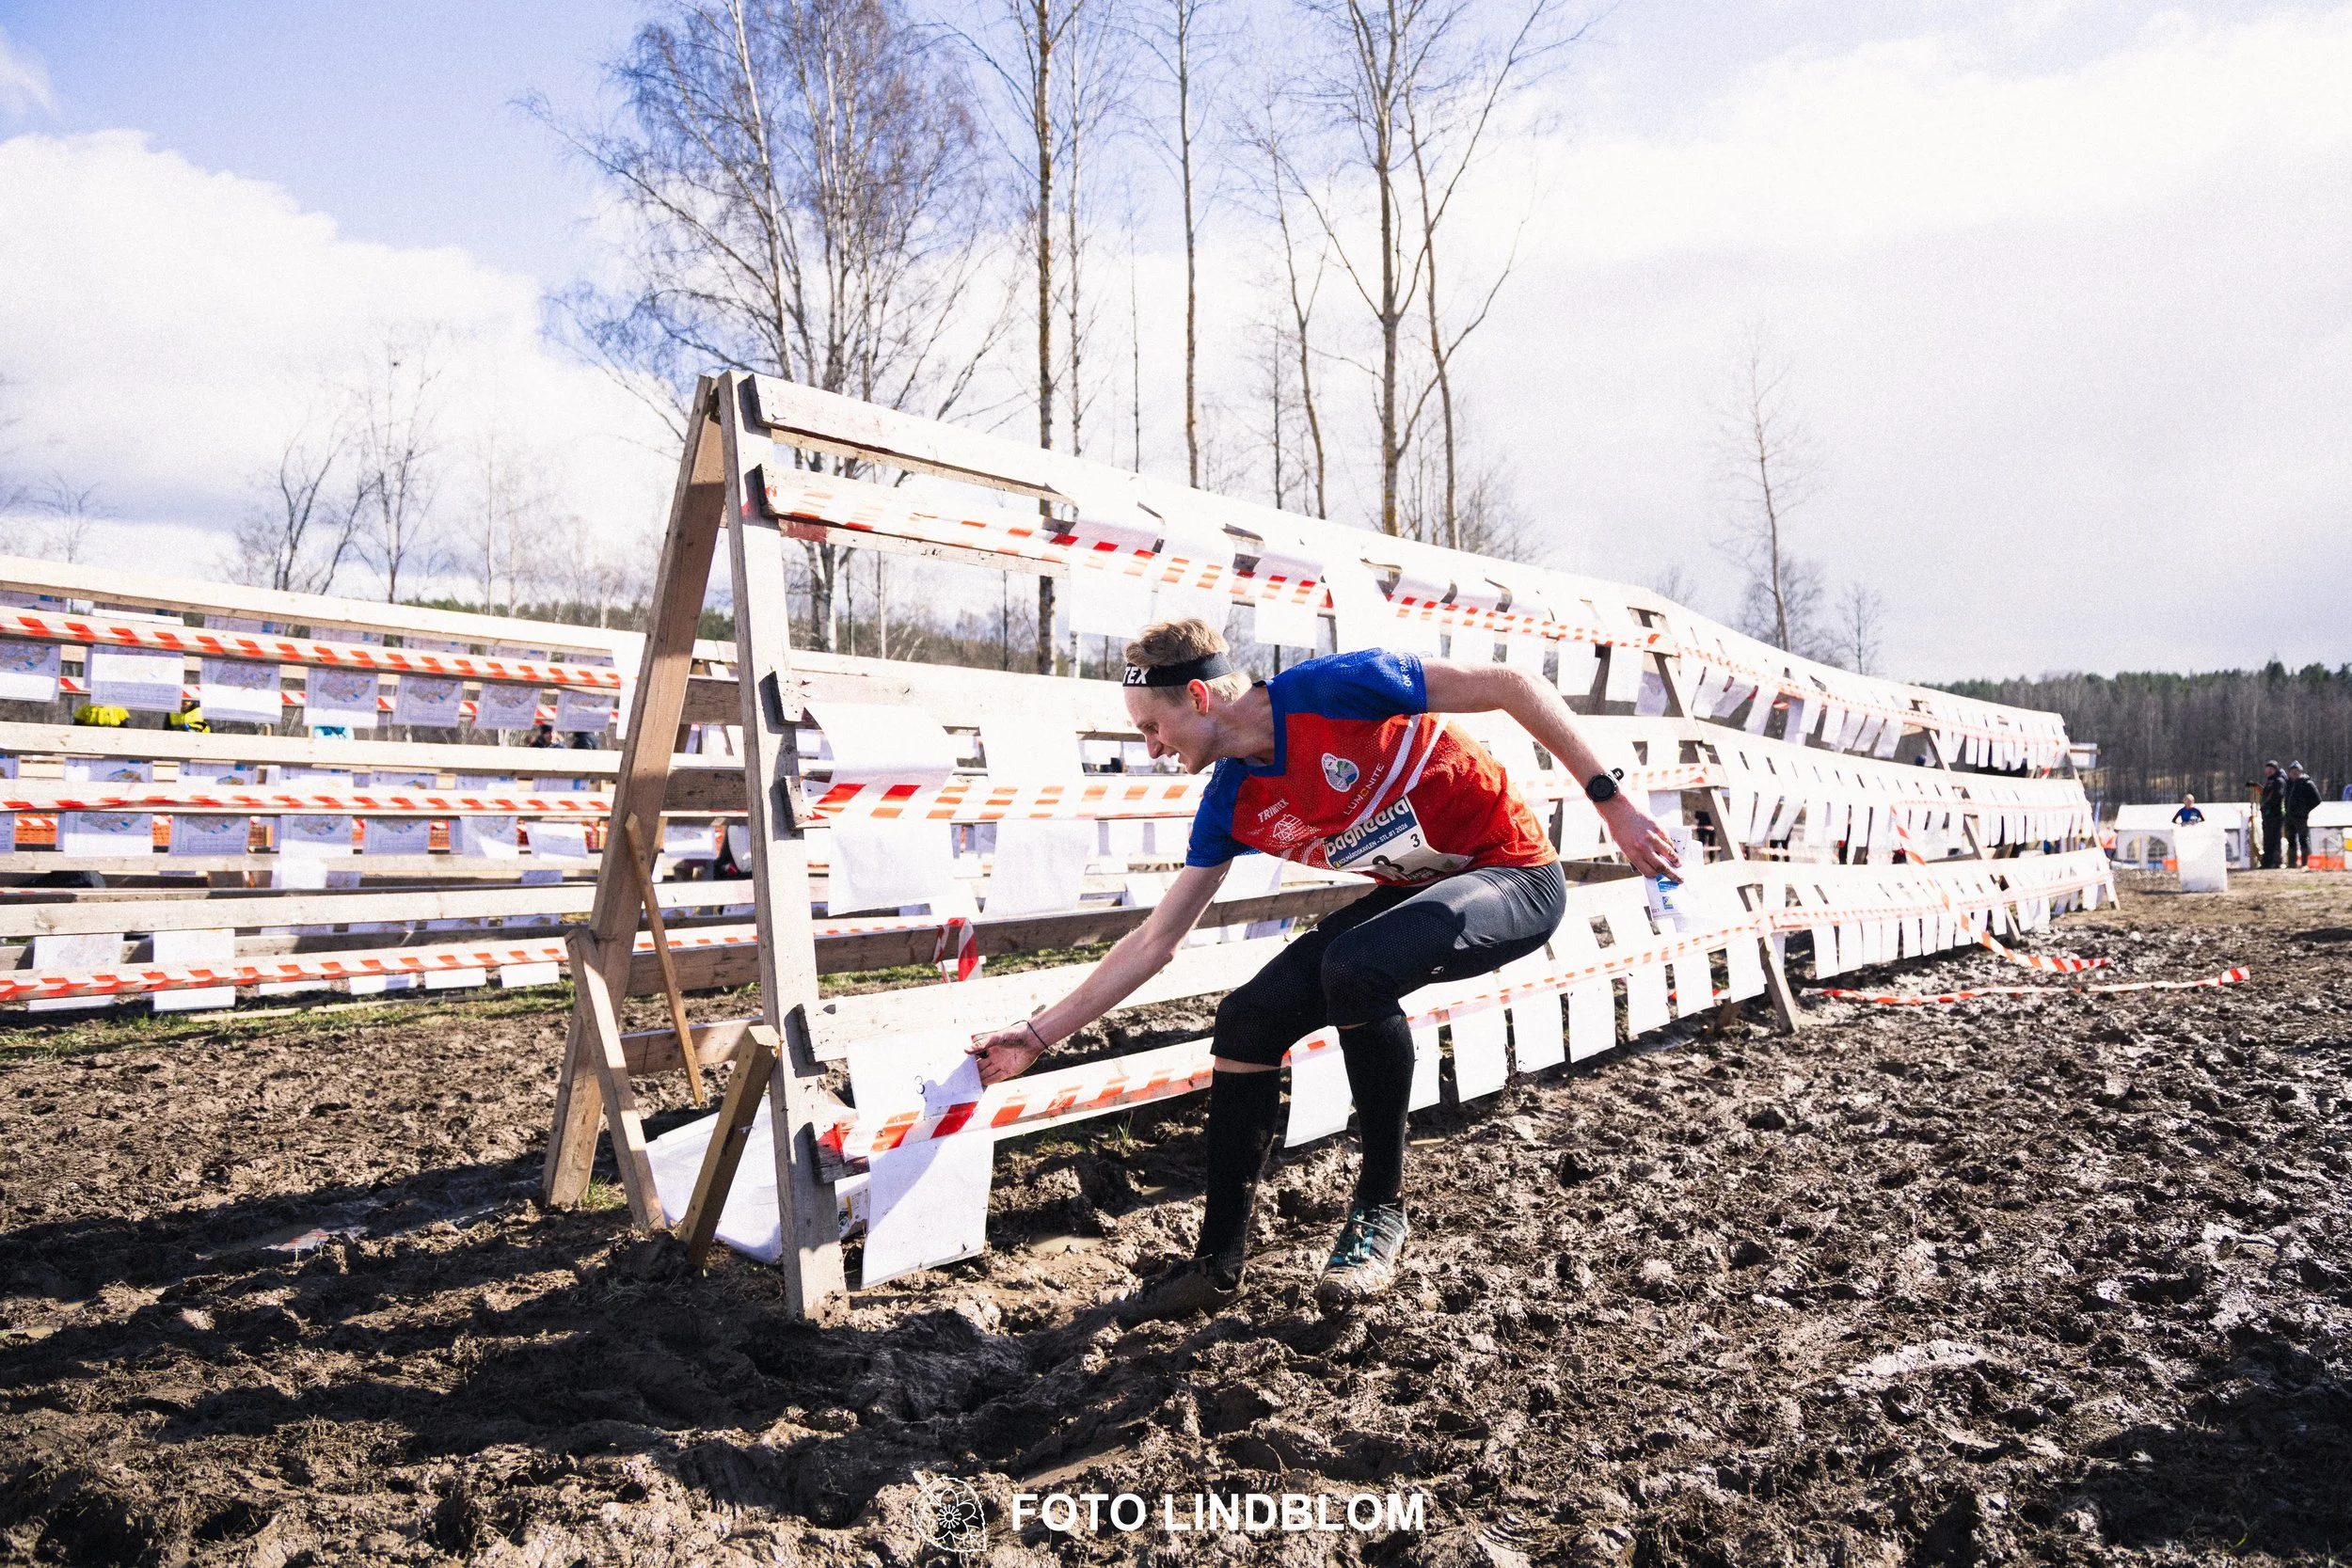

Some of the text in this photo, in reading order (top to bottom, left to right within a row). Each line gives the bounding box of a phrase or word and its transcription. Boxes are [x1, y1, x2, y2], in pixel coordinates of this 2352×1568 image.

[1402, 673, 1412, 687] OK
[1343, 763, 1385, 816] LUMONITE
[1257, 798, 1290, 823] TRIMTEX
[1378, 833, 1390, 842] STL
[1394, 822, 1408, 833] 2026
[1409, 832, 1421, 848] 3
